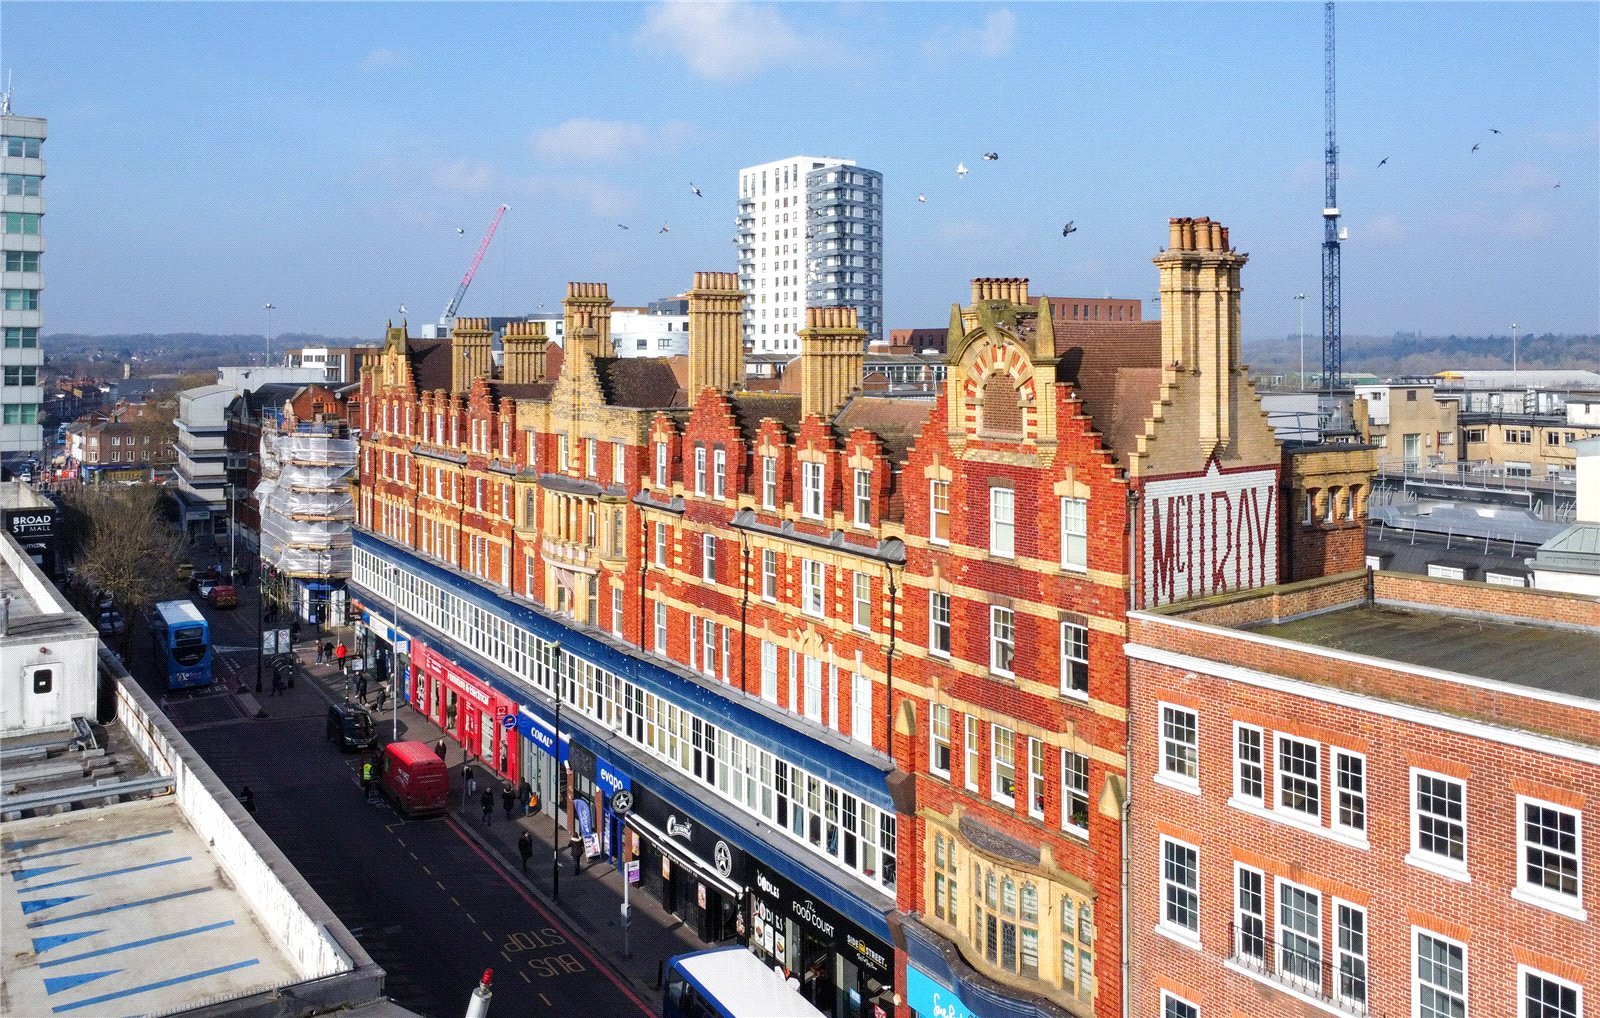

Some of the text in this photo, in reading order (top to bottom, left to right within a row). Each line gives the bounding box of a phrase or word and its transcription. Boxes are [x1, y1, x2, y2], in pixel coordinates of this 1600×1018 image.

[13, 515, 51, 525] BROAD
[13, 525, 26, 533] ST
[531, 726, 550, 748] CORAL
[600, 768, 623, 792] evapo
[804, 900, 817, 913] The
[792, 900, 835, 938] FOOD COURT
[503, 928, 566, 952] STOP
[528, 953, 586, 977] BUS
[865, 946, 885, 966] STREET
